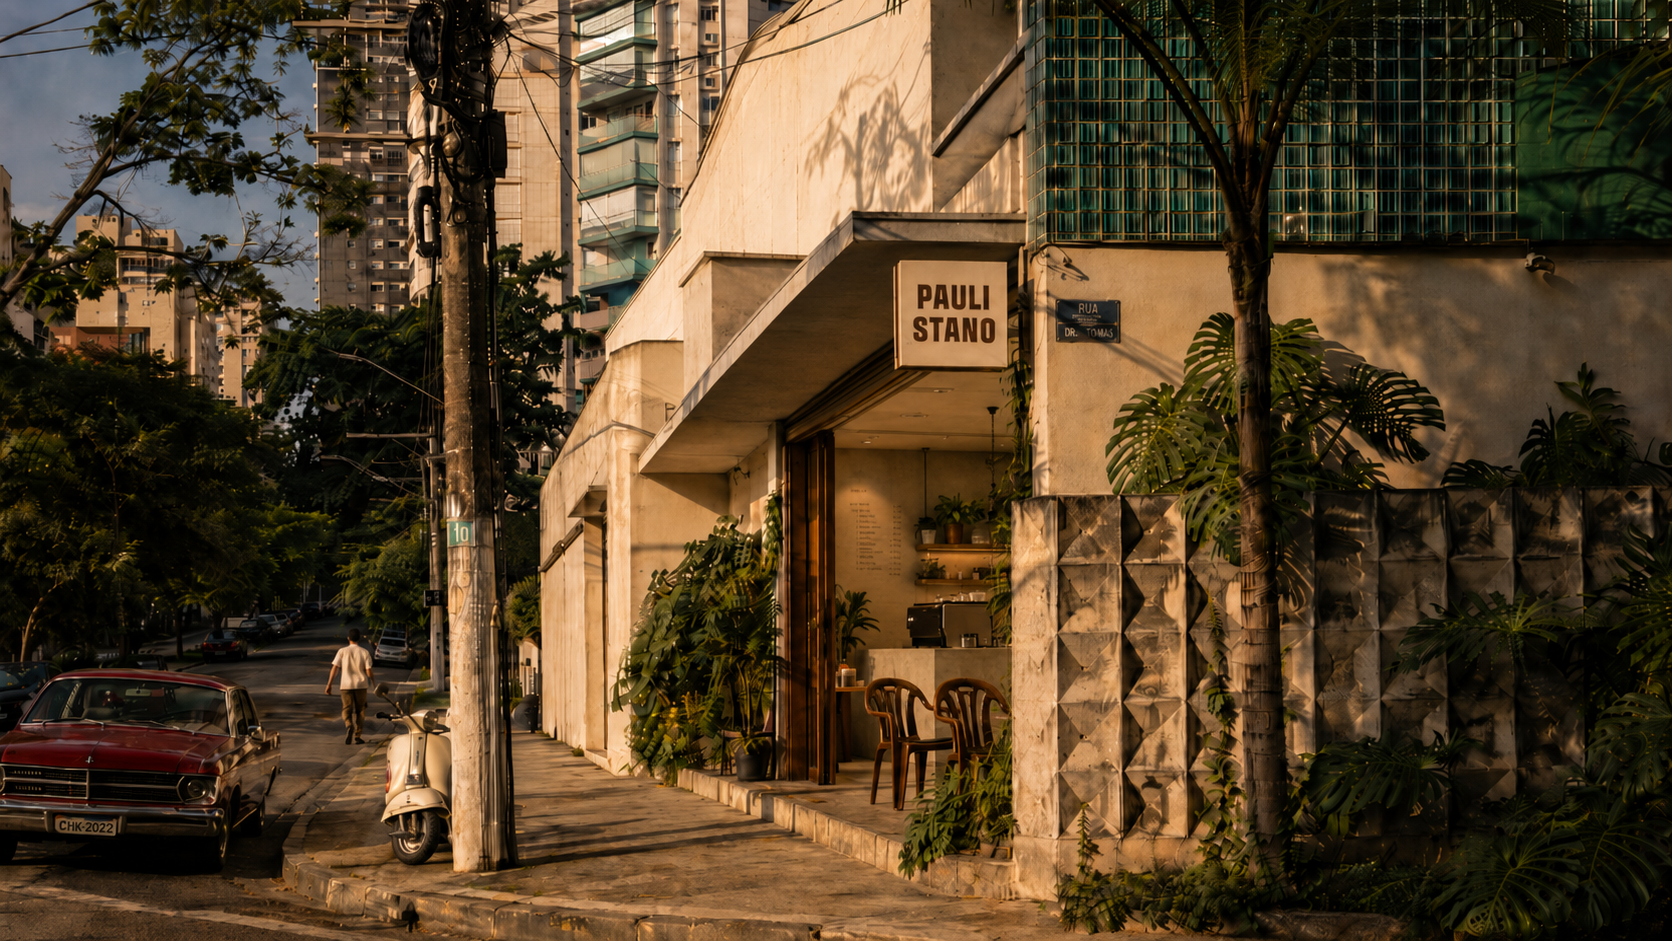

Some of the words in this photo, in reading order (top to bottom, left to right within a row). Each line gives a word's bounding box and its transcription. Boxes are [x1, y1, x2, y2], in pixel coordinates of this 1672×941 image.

[917, 284, 990, 310] PAULI
[1078, 303, 1098, 314] RUA
[912, 316, 996, 344] STANO
[1064, 327, 1078, 337] DR.
[453, 522, 469, 542] 10
[59, 820, 114, 833] CHK-2022
